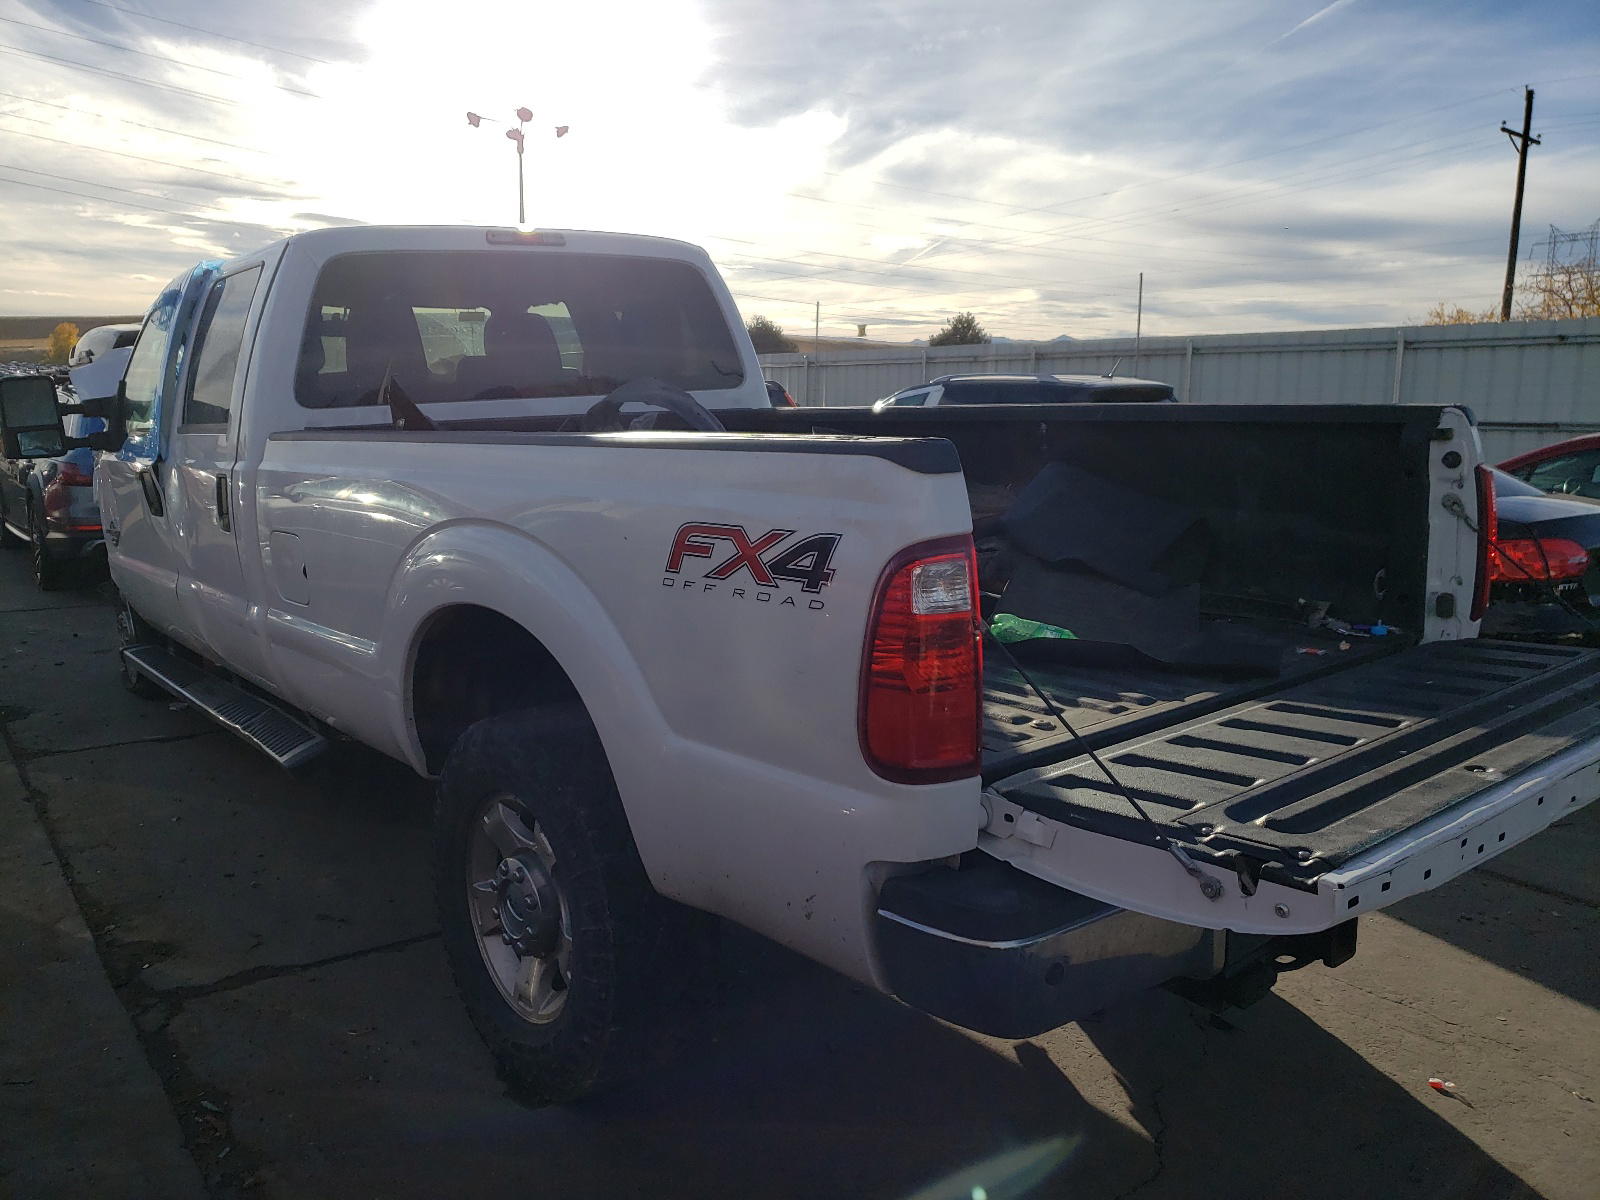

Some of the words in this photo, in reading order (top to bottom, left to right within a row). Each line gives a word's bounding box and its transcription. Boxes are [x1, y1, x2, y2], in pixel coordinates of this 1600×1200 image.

[665, 521, 843, 594] FX4
[662, 577, 717, 592] OFF
[732, 588, 825, 610] ROAD
